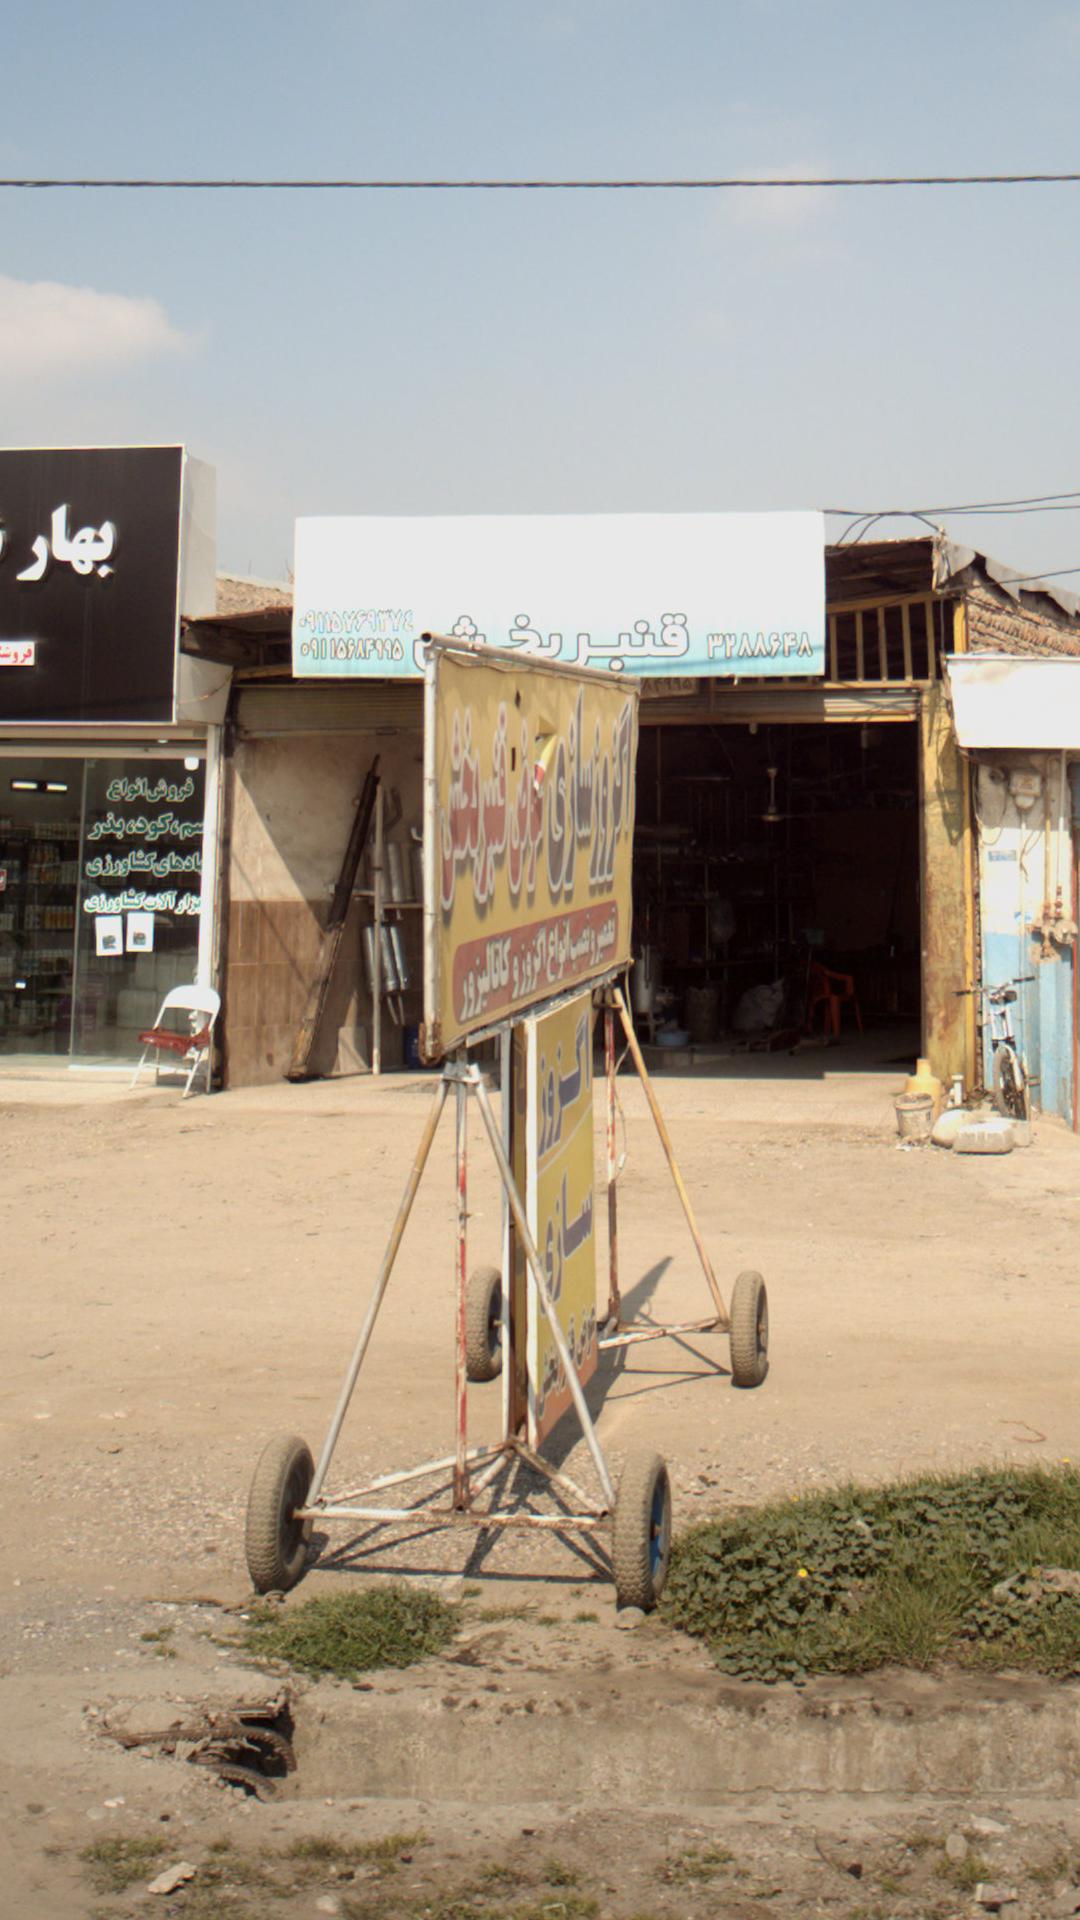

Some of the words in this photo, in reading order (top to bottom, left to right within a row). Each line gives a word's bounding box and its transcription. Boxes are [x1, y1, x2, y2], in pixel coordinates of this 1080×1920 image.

[16, 503, 116, 581] بهار
[106, 776, 148, 802] انواع
[147, 776, 195, 802] فروش
[87, 811, 126, 840] بذر
[84, 848, 157, 878] کشاورزی
[83, 889, 146, 914] کشاورزی
[537, 1007, 590, 1160] اگزوز
